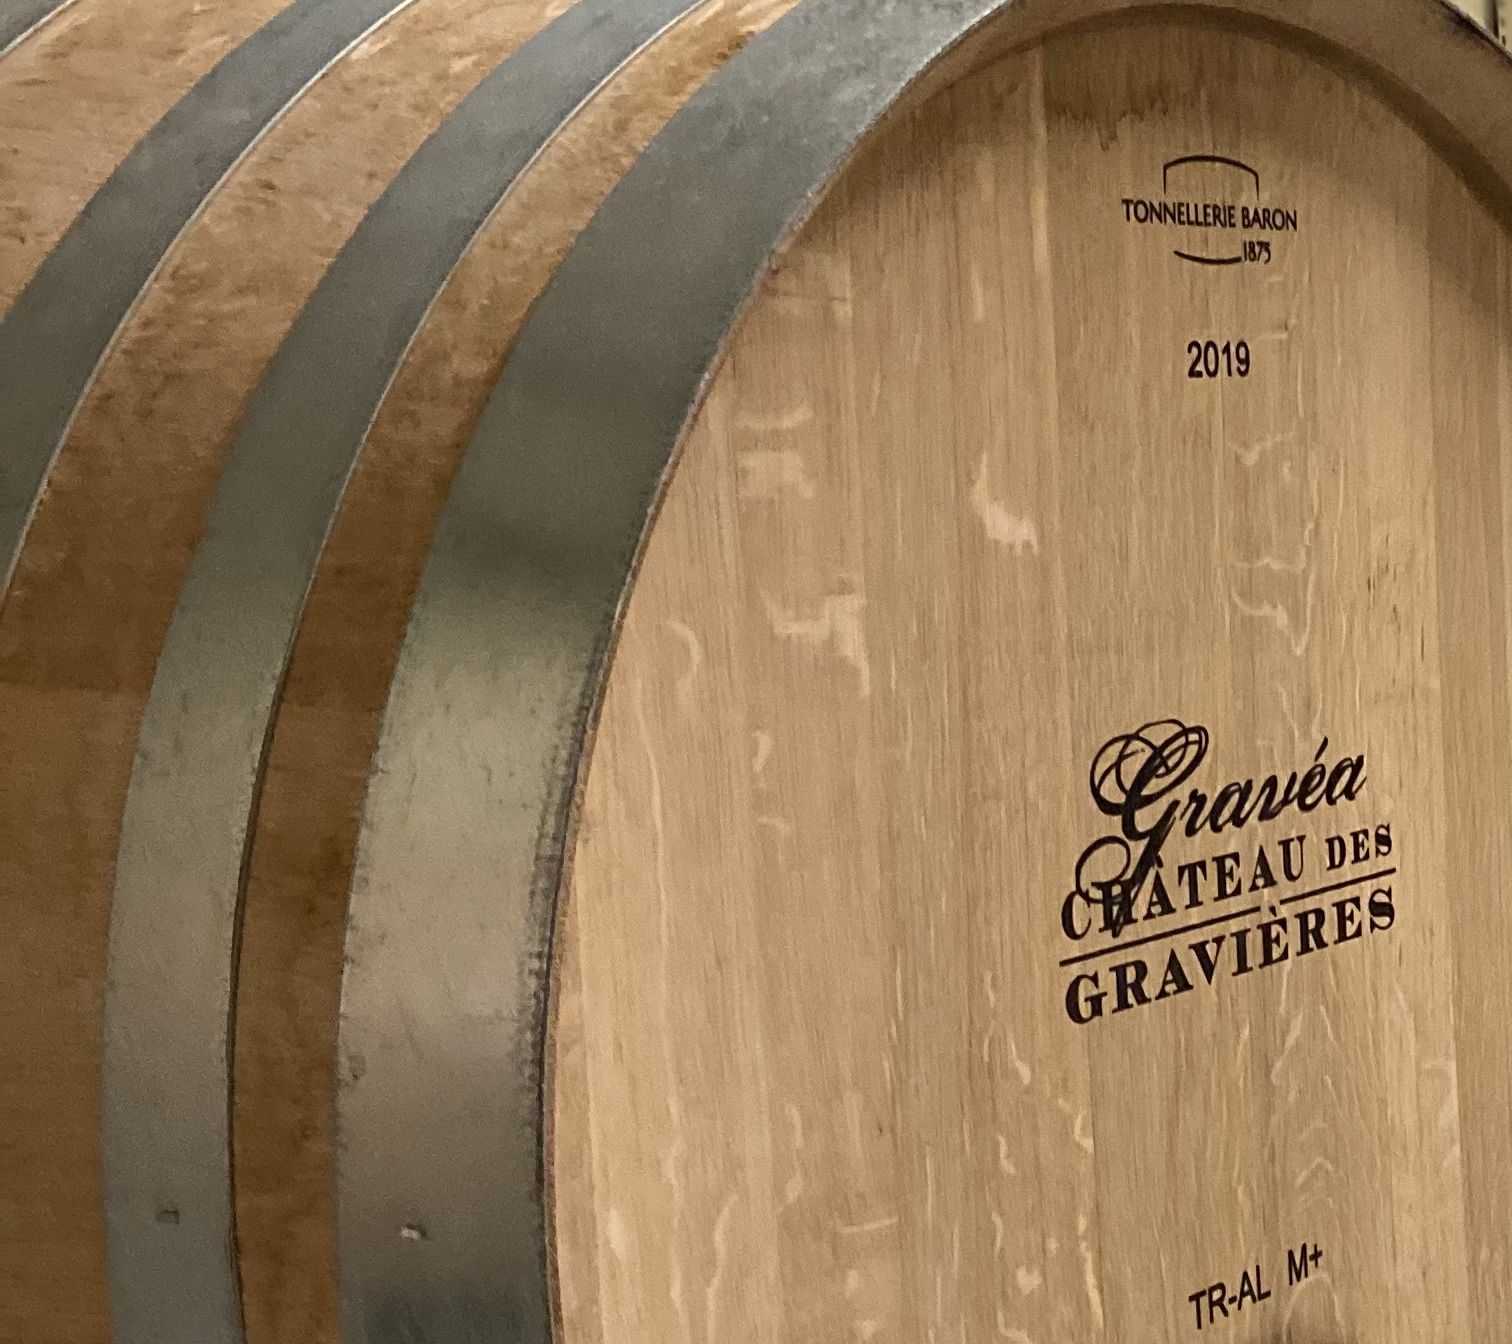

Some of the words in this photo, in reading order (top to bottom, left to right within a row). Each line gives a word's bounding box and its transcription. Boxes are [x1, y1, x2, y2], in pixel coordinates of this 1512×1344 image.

[1121, 198, 1236, 229] TONNELLERIE
[1241, 206, 1297, 232] BARON
[1187, 340, 1250, 378] 2019
[1075, 718, 1367, 938] Gravéa
[1325, 823, 1393, 871] DES
[1064, 886, 1396, 1025] GRAVIÈRES
[1188, 1264, 1271, 1330] TR-AL
[1287, 1242, 1322, 1286] M+
